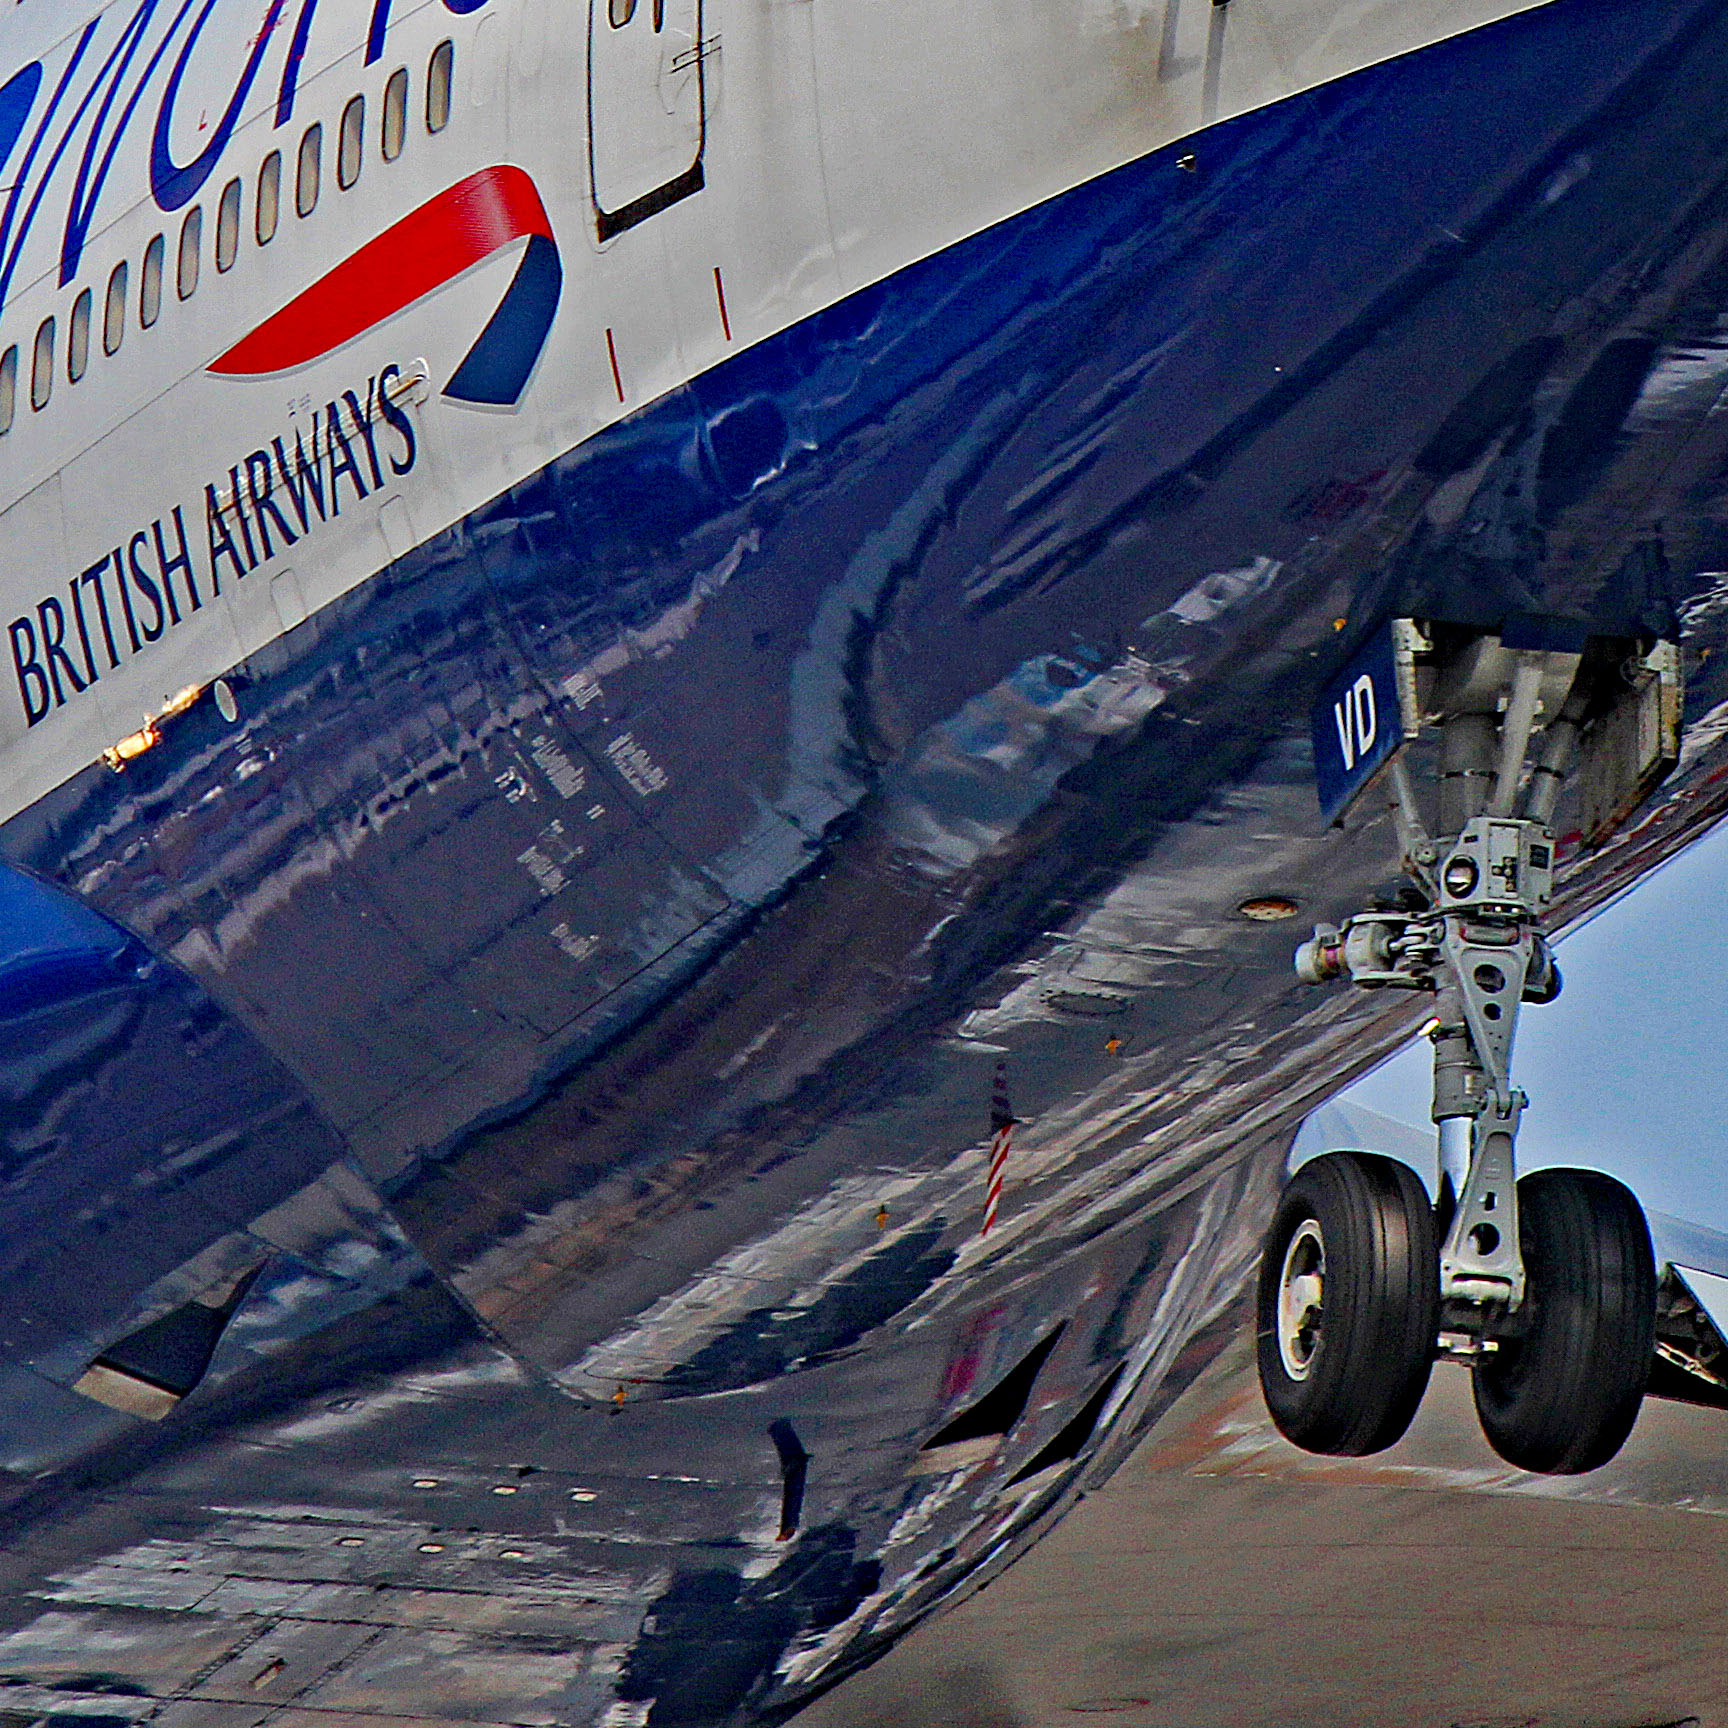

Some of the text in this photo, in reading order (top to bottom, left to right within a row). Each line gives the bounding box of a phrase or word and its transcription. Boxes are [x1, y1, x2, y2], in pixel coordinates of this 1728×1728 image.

[7, 363, 417, 728] BRITISH AIRWAYS
[1333, 673, 1378, 771] VD
